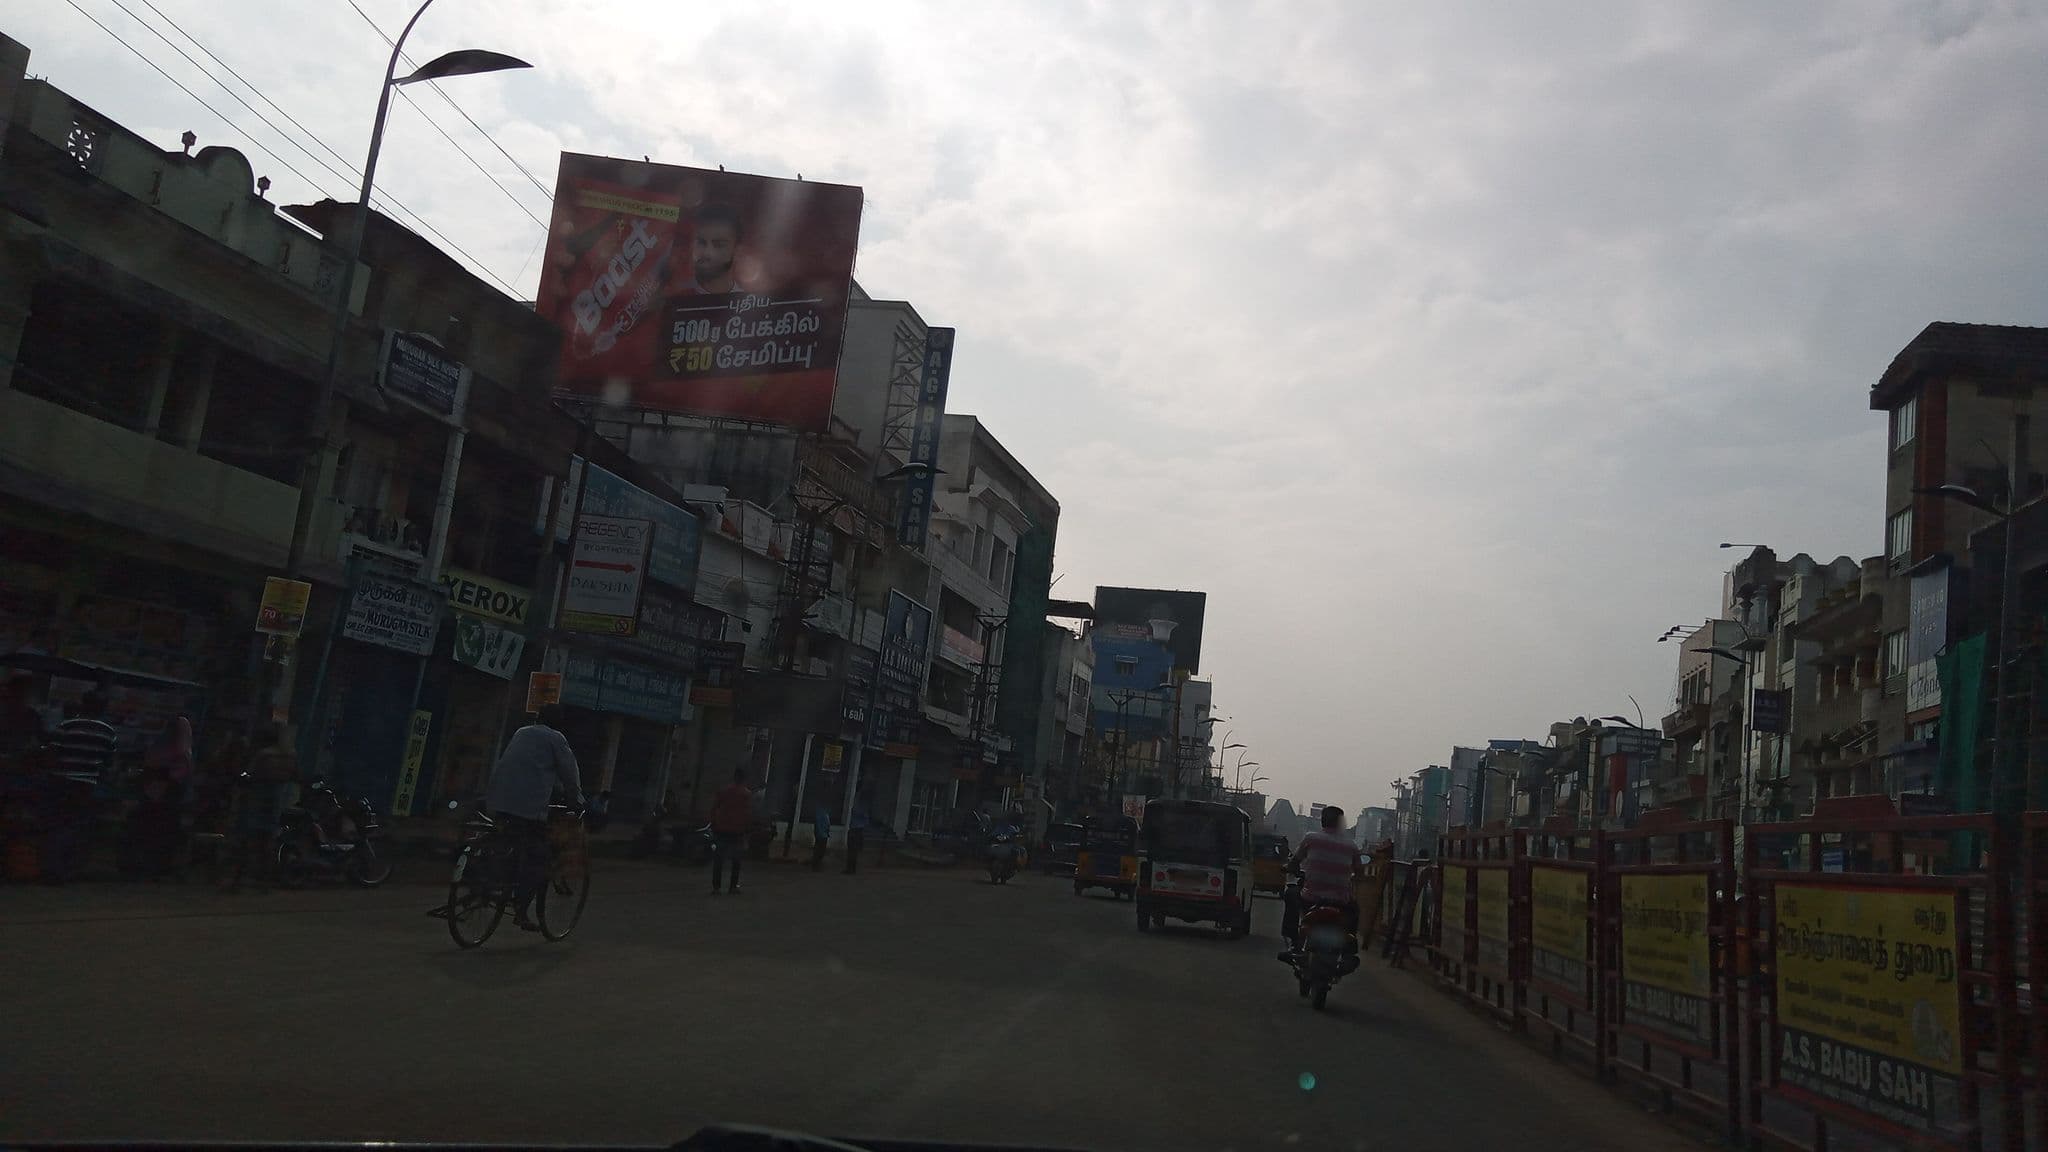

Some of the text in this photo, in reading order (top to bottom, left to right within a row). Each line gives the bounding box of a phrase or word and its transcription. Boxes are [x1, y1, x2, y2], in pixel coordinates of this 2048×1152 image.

[729, 294, 770, 313] புதிய
[673, 310, 820, 344] 500g பேக்கில்
[668, 347, 714, 374] ₹50
[579, 520, 648, 541] REGENCY
[440, 574, 527, 621] XEROX
[1782, 1031, 1816, 1072] A.S.
[1820, 1041, 1871, 1090] BABU
[1878, 1060, 1929, 1112] SAH
